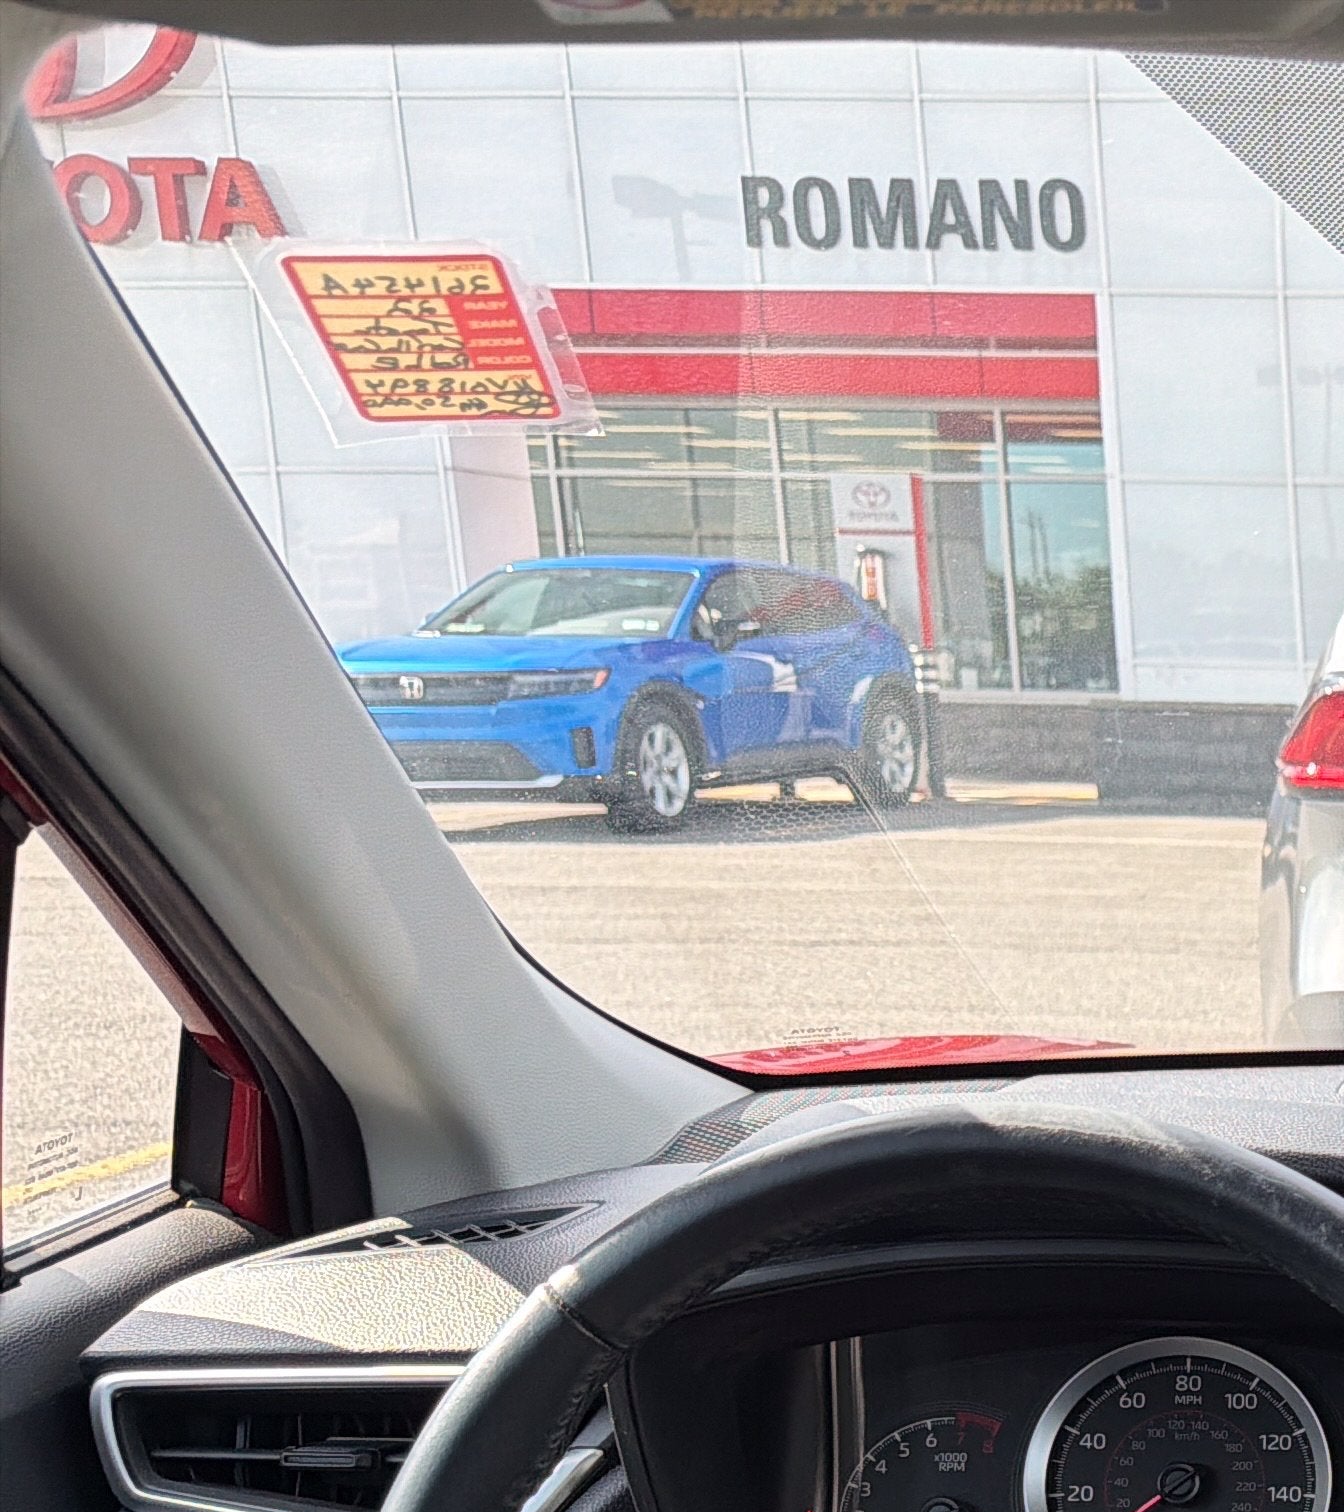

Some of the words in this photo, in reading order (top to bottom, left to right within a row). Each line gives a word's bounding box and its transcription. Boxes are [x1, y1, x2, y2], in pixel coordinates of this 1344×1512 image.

[53, 153, 288, 245] OTA
[741, 174, 1087, 252] ROMANO
[1175, 1375, 1202, 1392] 80
[1119, 1392, 1146, 1409] 60
[1174, 1395, 1202, 1405] MPH
[1224, 1393, 1258, 1410] 100
[1168, 1420, 1186, 1430] 120
[1190, 1421, 1210, 1431] 140
[1148, 1428, 1165, 1438] 100
[1174, 1431, 1201, 1441] km/h
[1210, 1431, 1229, 1440] 160
[926, 1433, 937, 1447] 6
[1079, 1433, 1106, 1450] 40
[1132, 1440, 1146, 1450] 80
[1258, 1434, 1292, 1451] 120
[899, 1442, 910, 1458] 5
[1225, 1443, 1243, 1453] 180
[934, 1452, 968, 1463] x1000
[1119, 1457, 1134, 1466] 60
[875, 1460, 888, 1474] 4
[938, 1462, 966, 1472] RPM
[1232, 1461, 1253, 1471] 200
[1114, 1477, 1129, 1487] 40
[1235, 1481, 1257, 1491] 220
[861, 1482, 871, 1497] 3
[1067, 1485, 1094, 1502] 20
[1267, 1486, 1302, 1503] 140
[1116, 1499, 1131, 1508] 20
[1231, 1503, 1252, 1512] 240
